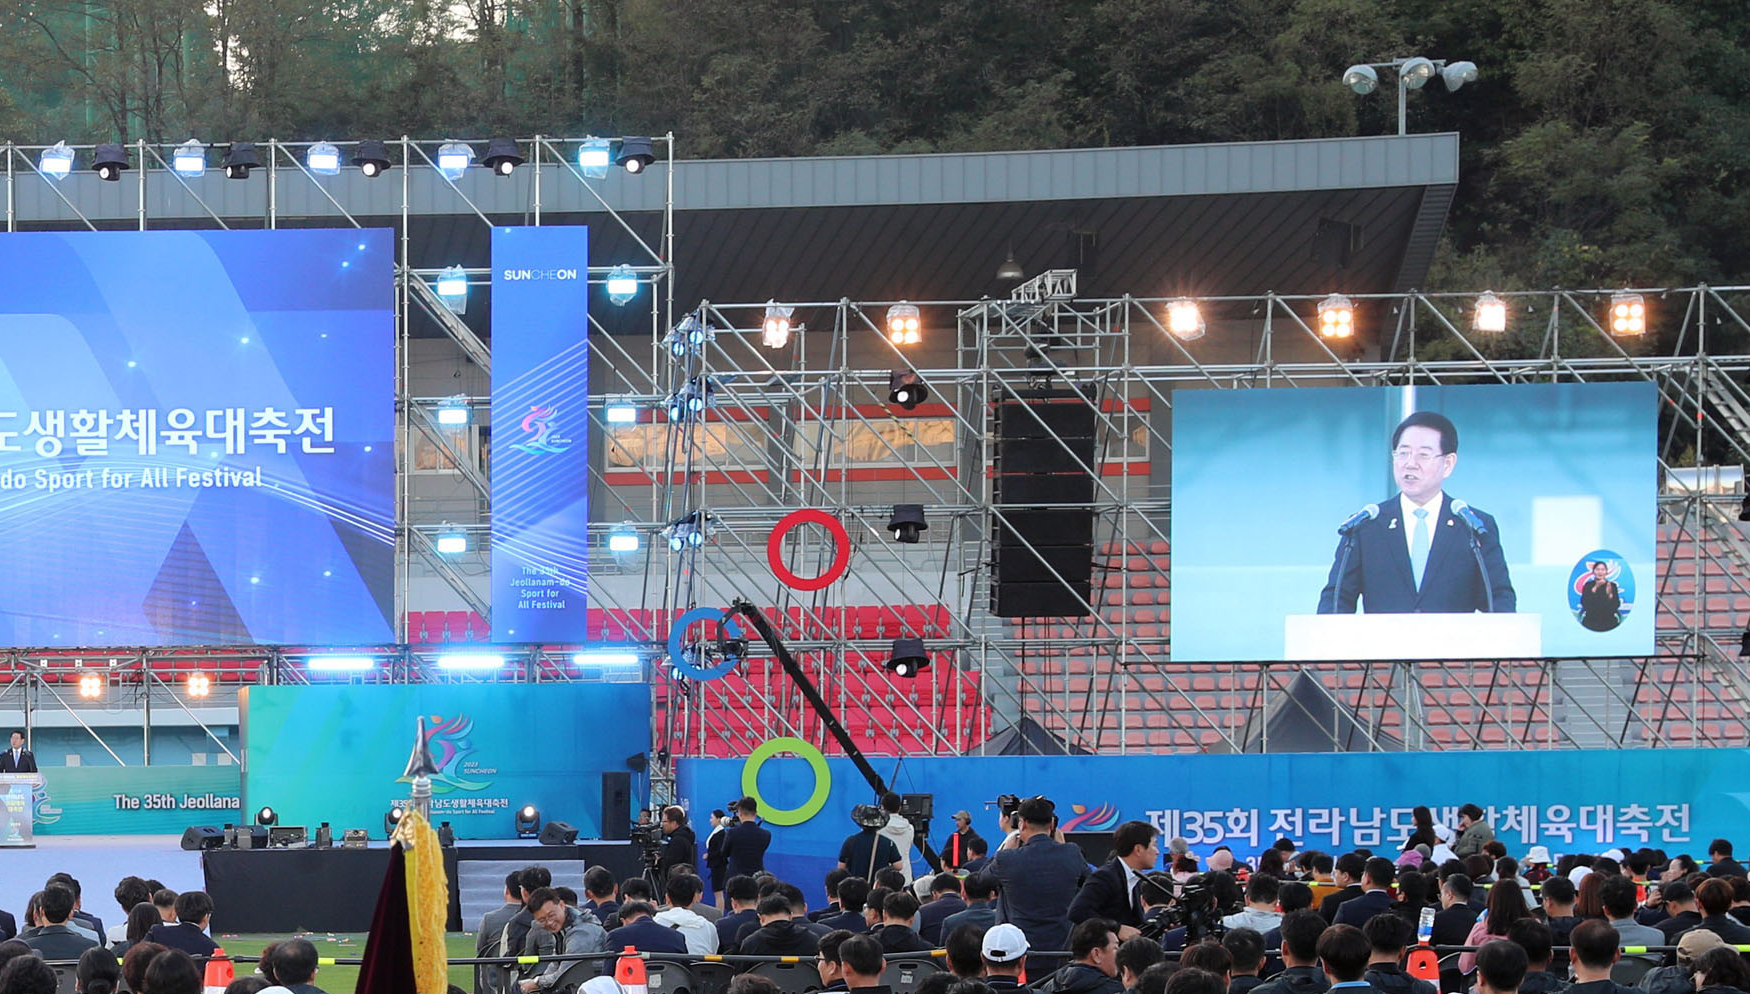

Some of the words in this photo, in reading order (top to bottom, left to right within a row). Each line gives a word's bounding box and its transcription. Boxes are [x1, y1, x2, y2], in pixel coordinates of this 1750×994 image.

[504, 269, 577, 280] SUNCHEON
[35, 467, 94, 492] Sport
[102, 467, 137, 489] for
[140, 467, 168, 488] All
[176, 466, 262, 488] Festival
[522, 567, 537, 575] The
[521, 589, 544, 599] Sport
[547, 589, 559, 598] for
[518, 600, 529, 609] All
[531, 600, 566, 609] Festival
[114, 794, 140, 809] The
[143, 794, 176, 809] 35th
[1146, 807, 1258, 847] 제35회
